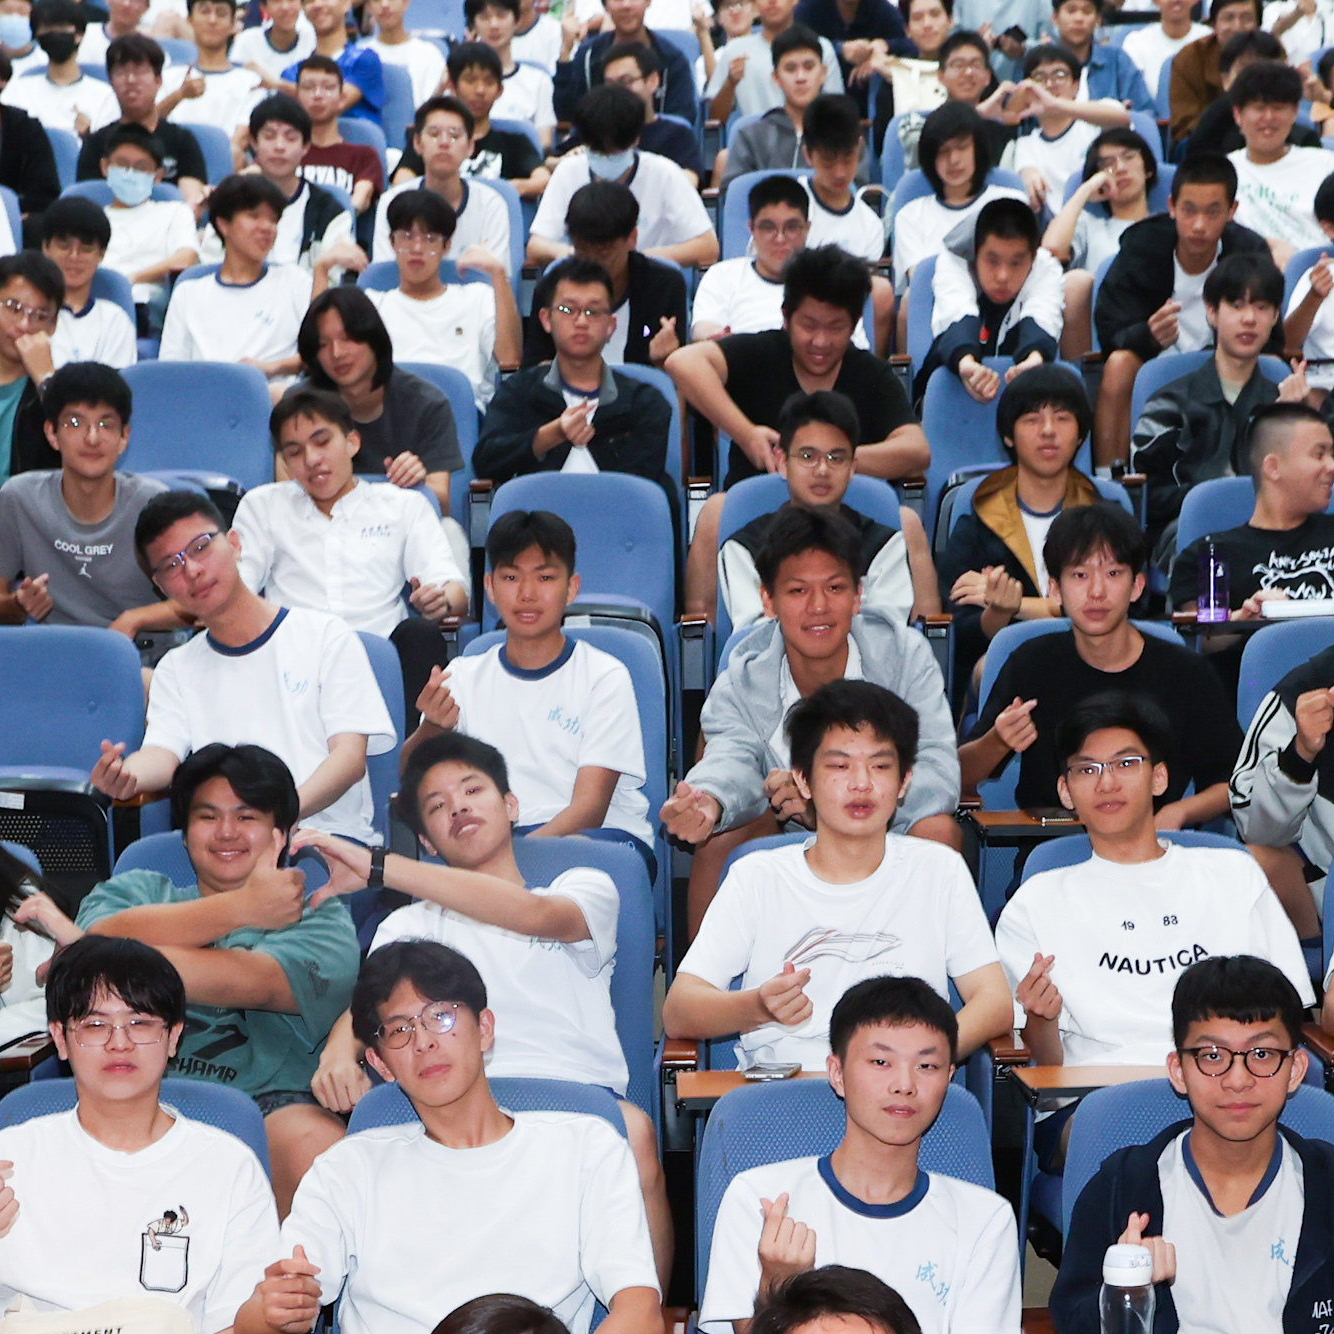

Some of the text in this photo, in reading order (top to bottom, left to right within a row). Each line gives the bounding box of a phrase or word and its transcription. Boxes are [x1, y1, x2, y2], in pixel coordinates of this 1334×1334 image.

[54, 540, 115, 556] COOL GREY
[1121, 915, 1179, 931] 19 83
[1099, 943, 1209, 975] NAUTICA
[1271, 1237, 1296, 1270] 成
